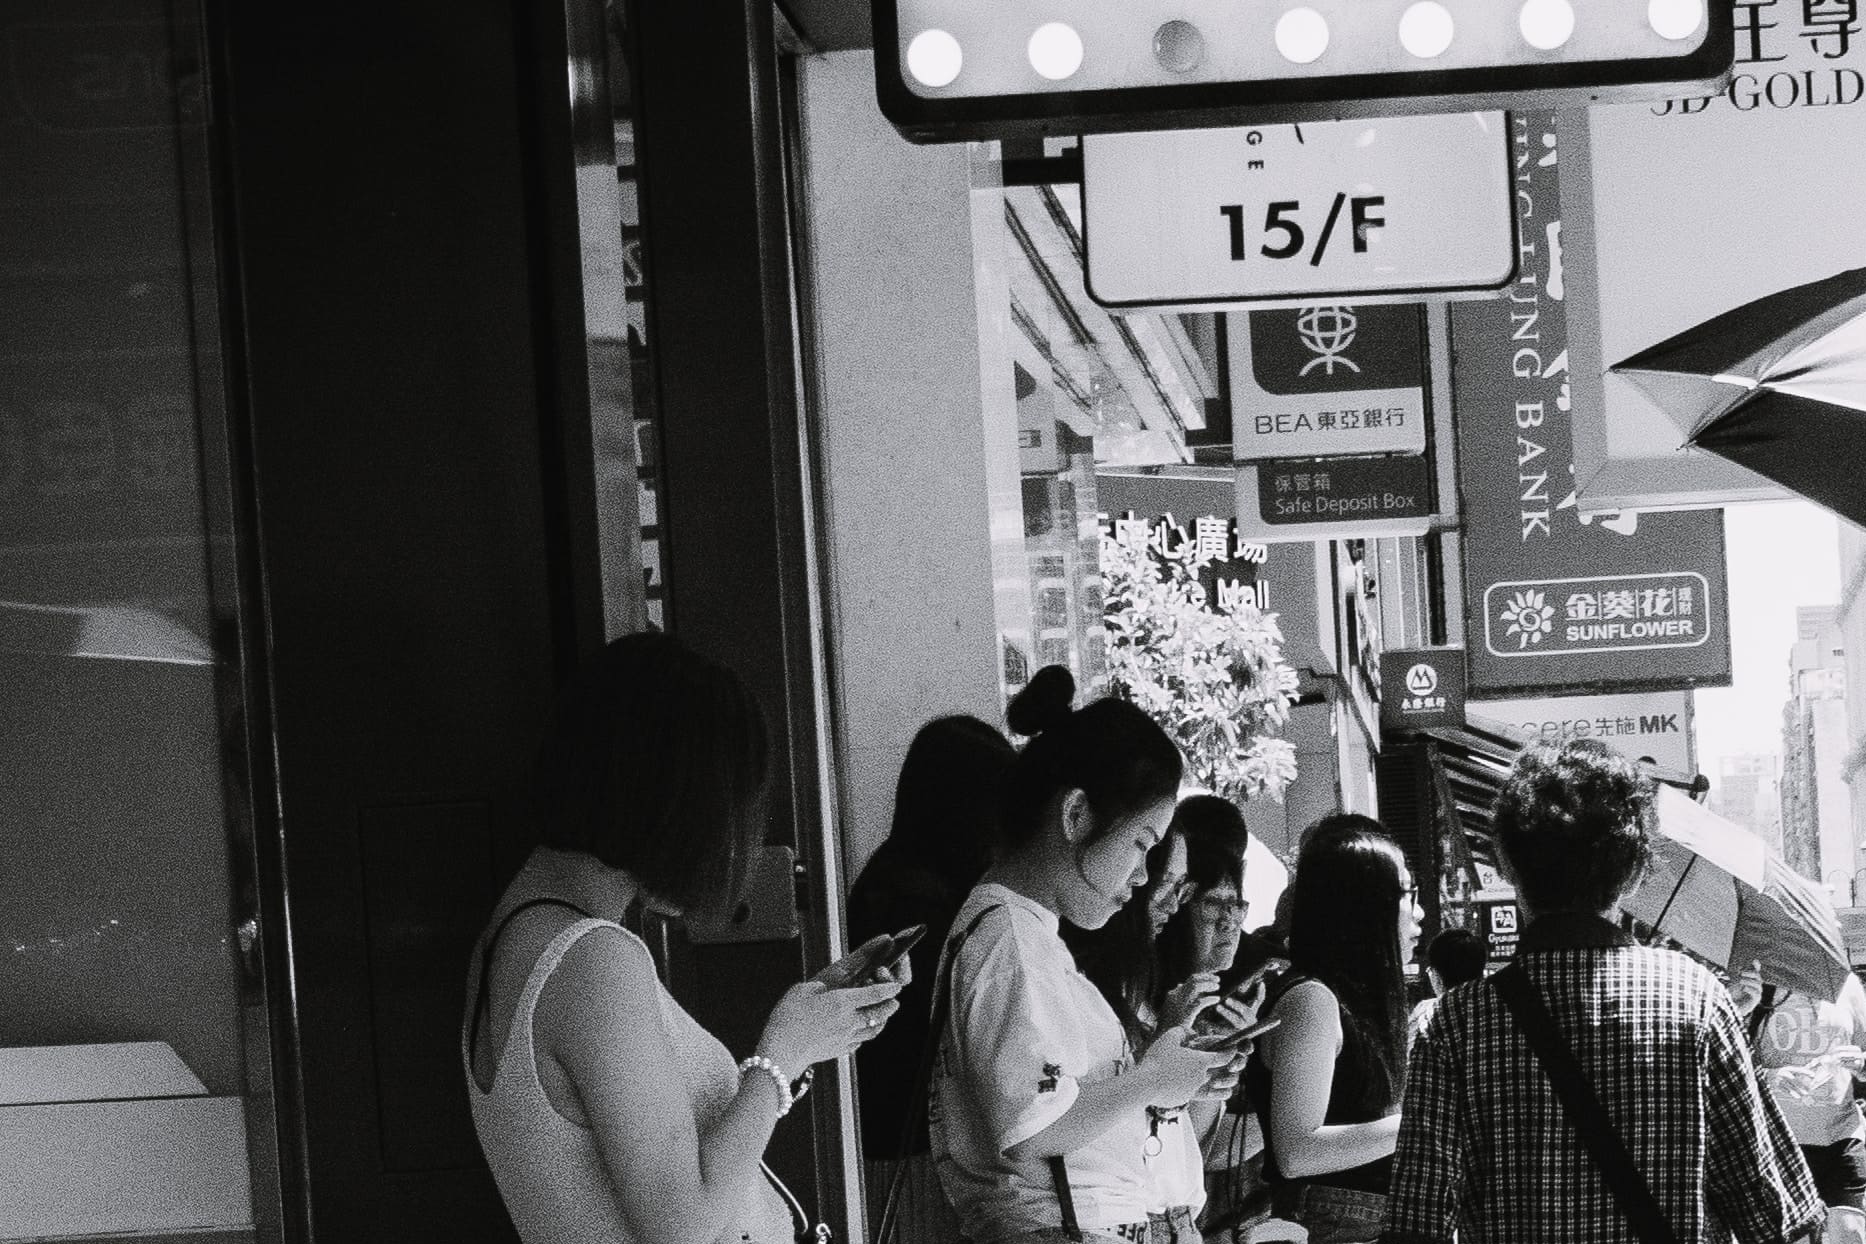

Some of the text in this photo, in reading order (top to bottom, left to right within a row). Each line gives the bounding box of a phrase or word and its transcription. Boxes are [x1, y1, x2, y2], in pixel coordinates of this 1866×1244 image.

[1220, 192, 1386, 267] 15/F
[1255, 408, 1405, 434] BEA 東亞銀行
[1515, 400, 1551, 542] BANK
[1275, 492, 1416, 515] Safe Deposit Box
[1566, 620, 1694, 642] SUNFLOWER
[1639, 713, 1679, 735] MK
